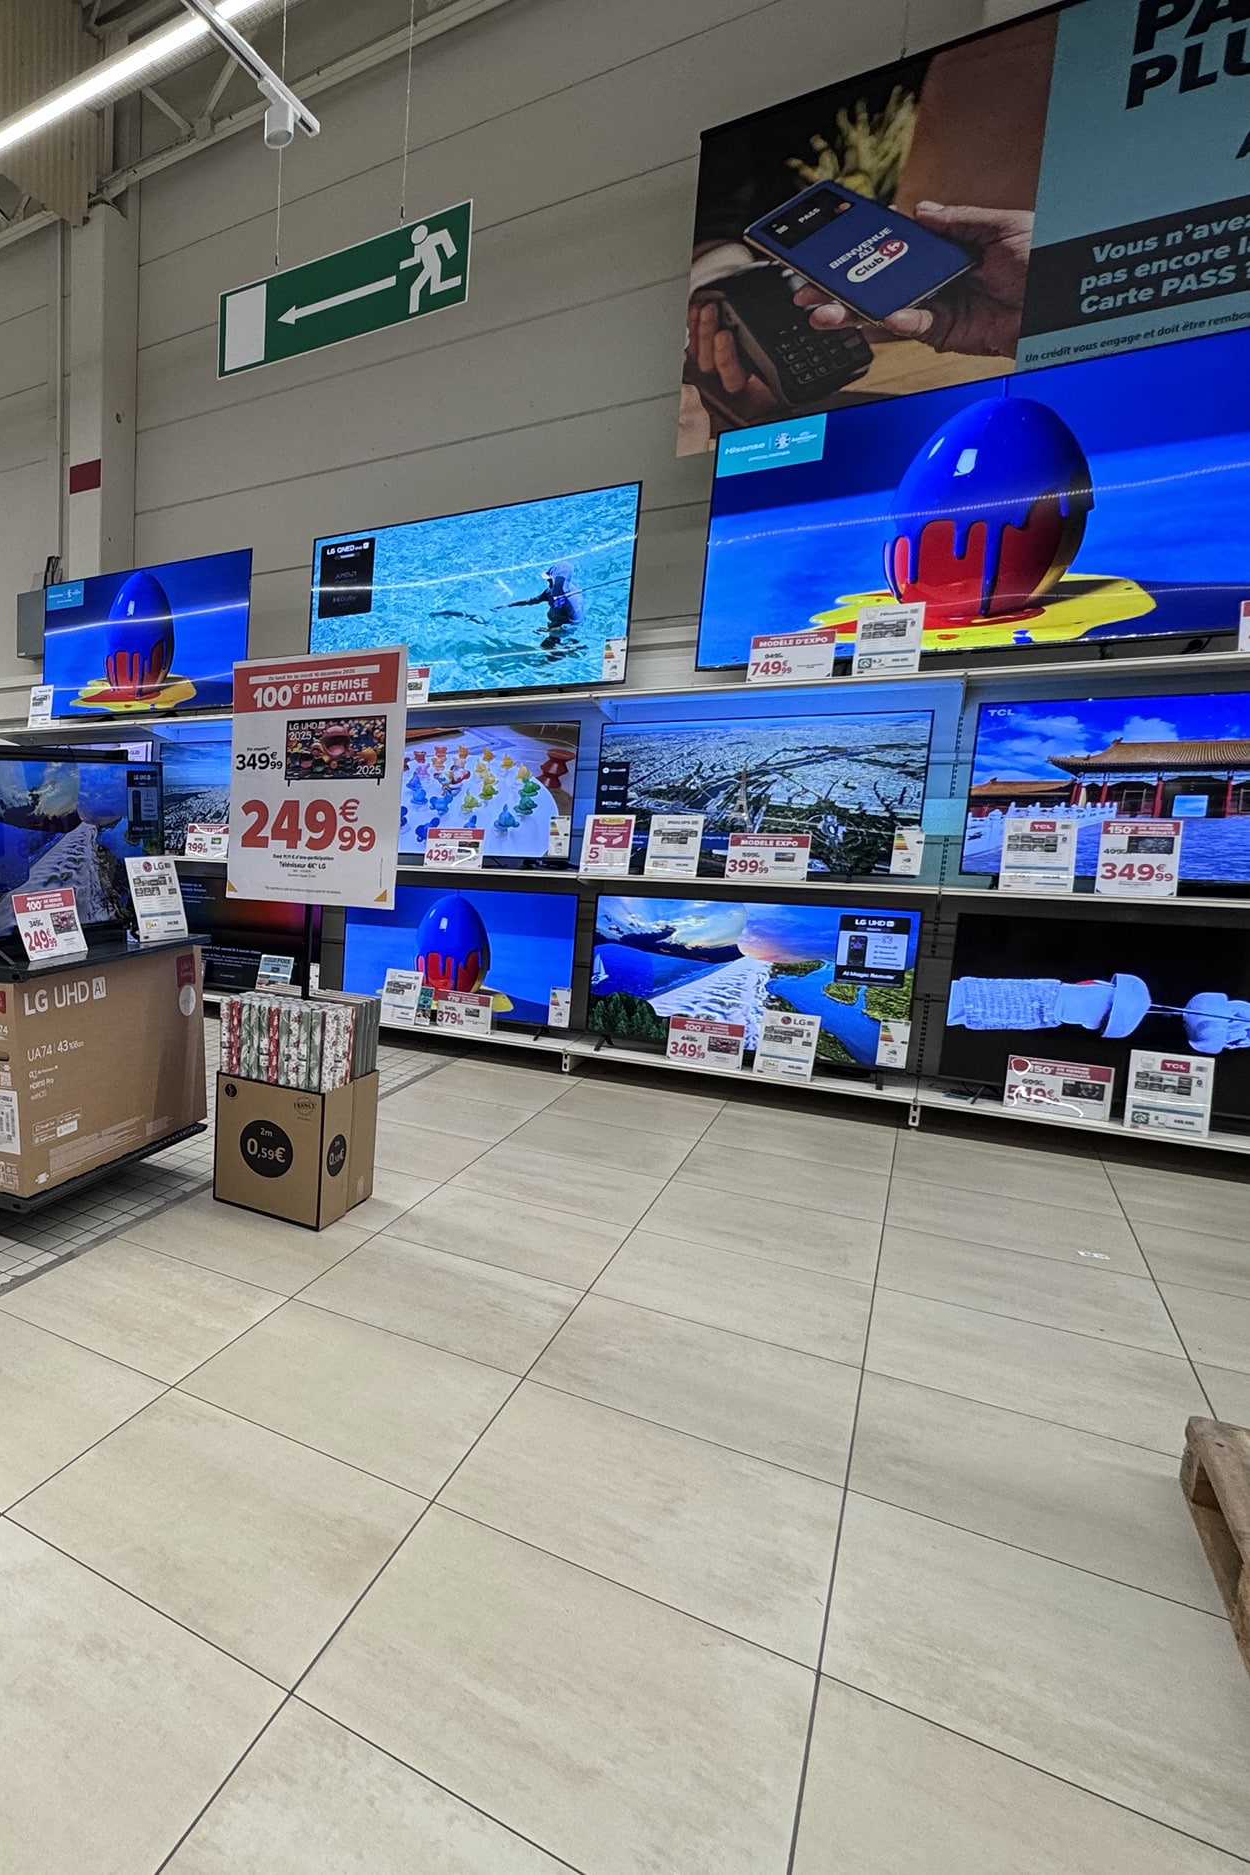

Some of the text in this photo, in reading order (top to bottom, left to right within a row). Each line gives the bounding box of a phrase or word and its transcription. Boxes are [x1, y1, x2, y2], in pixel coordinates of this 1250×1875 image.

[798, 207, 821, 223] PASS
[828, 226, 893, 270] BIENVENUE
[858, 246, 876, 260] AU
[1092, 235, 1158, 263] Vous
[854, 256, 885, 277] Club
[1080, 268, 1128, 295] pas
[1134, 244, 1231, 278] encore
[1080, 265, 1237, 314] Carte PASS
[1025, 353, 1039, 363] Un
[1041, 344, 1071, 361] crédit
[1073, 341, 1098, 354] vous
[1100, 332, 1142, 351] engage
[1143, 327, 1155, 339] et
[1158, 324, 1180, 337] doit
[725, 442, 766, 455] Hisense
[302, 678, 369, 693] DE REMISE
[253, 683, 300, 708] 100€
[302, 691, 373, 706] IMMÉDIATE
[988, 709, 1015, 717] TCL
[289, 722, 318, 731] LG UHD
[289, 731, 312, 741] 2025
[356, 765, 382, 775] 2025
[588, 847, 600, 859] 5
[153, 862, 164, 871] LG
[868, 919, 885, 927] UHD
[24, 989, 48, 1016] LG
[54, 981, 90, 1008] UHD
[793, 1018, 806, 1026] LG
[27, 1043, 53, 1062] UA74
[57, 1040, 69, 1053] 43
[1165, 1062, 1186, 1070] TCL
[46, 1077, 54, 1086] Pro
[260, 1127, 273, 1138] 2m
[247, 1138, 286, 1163] 0,59€
